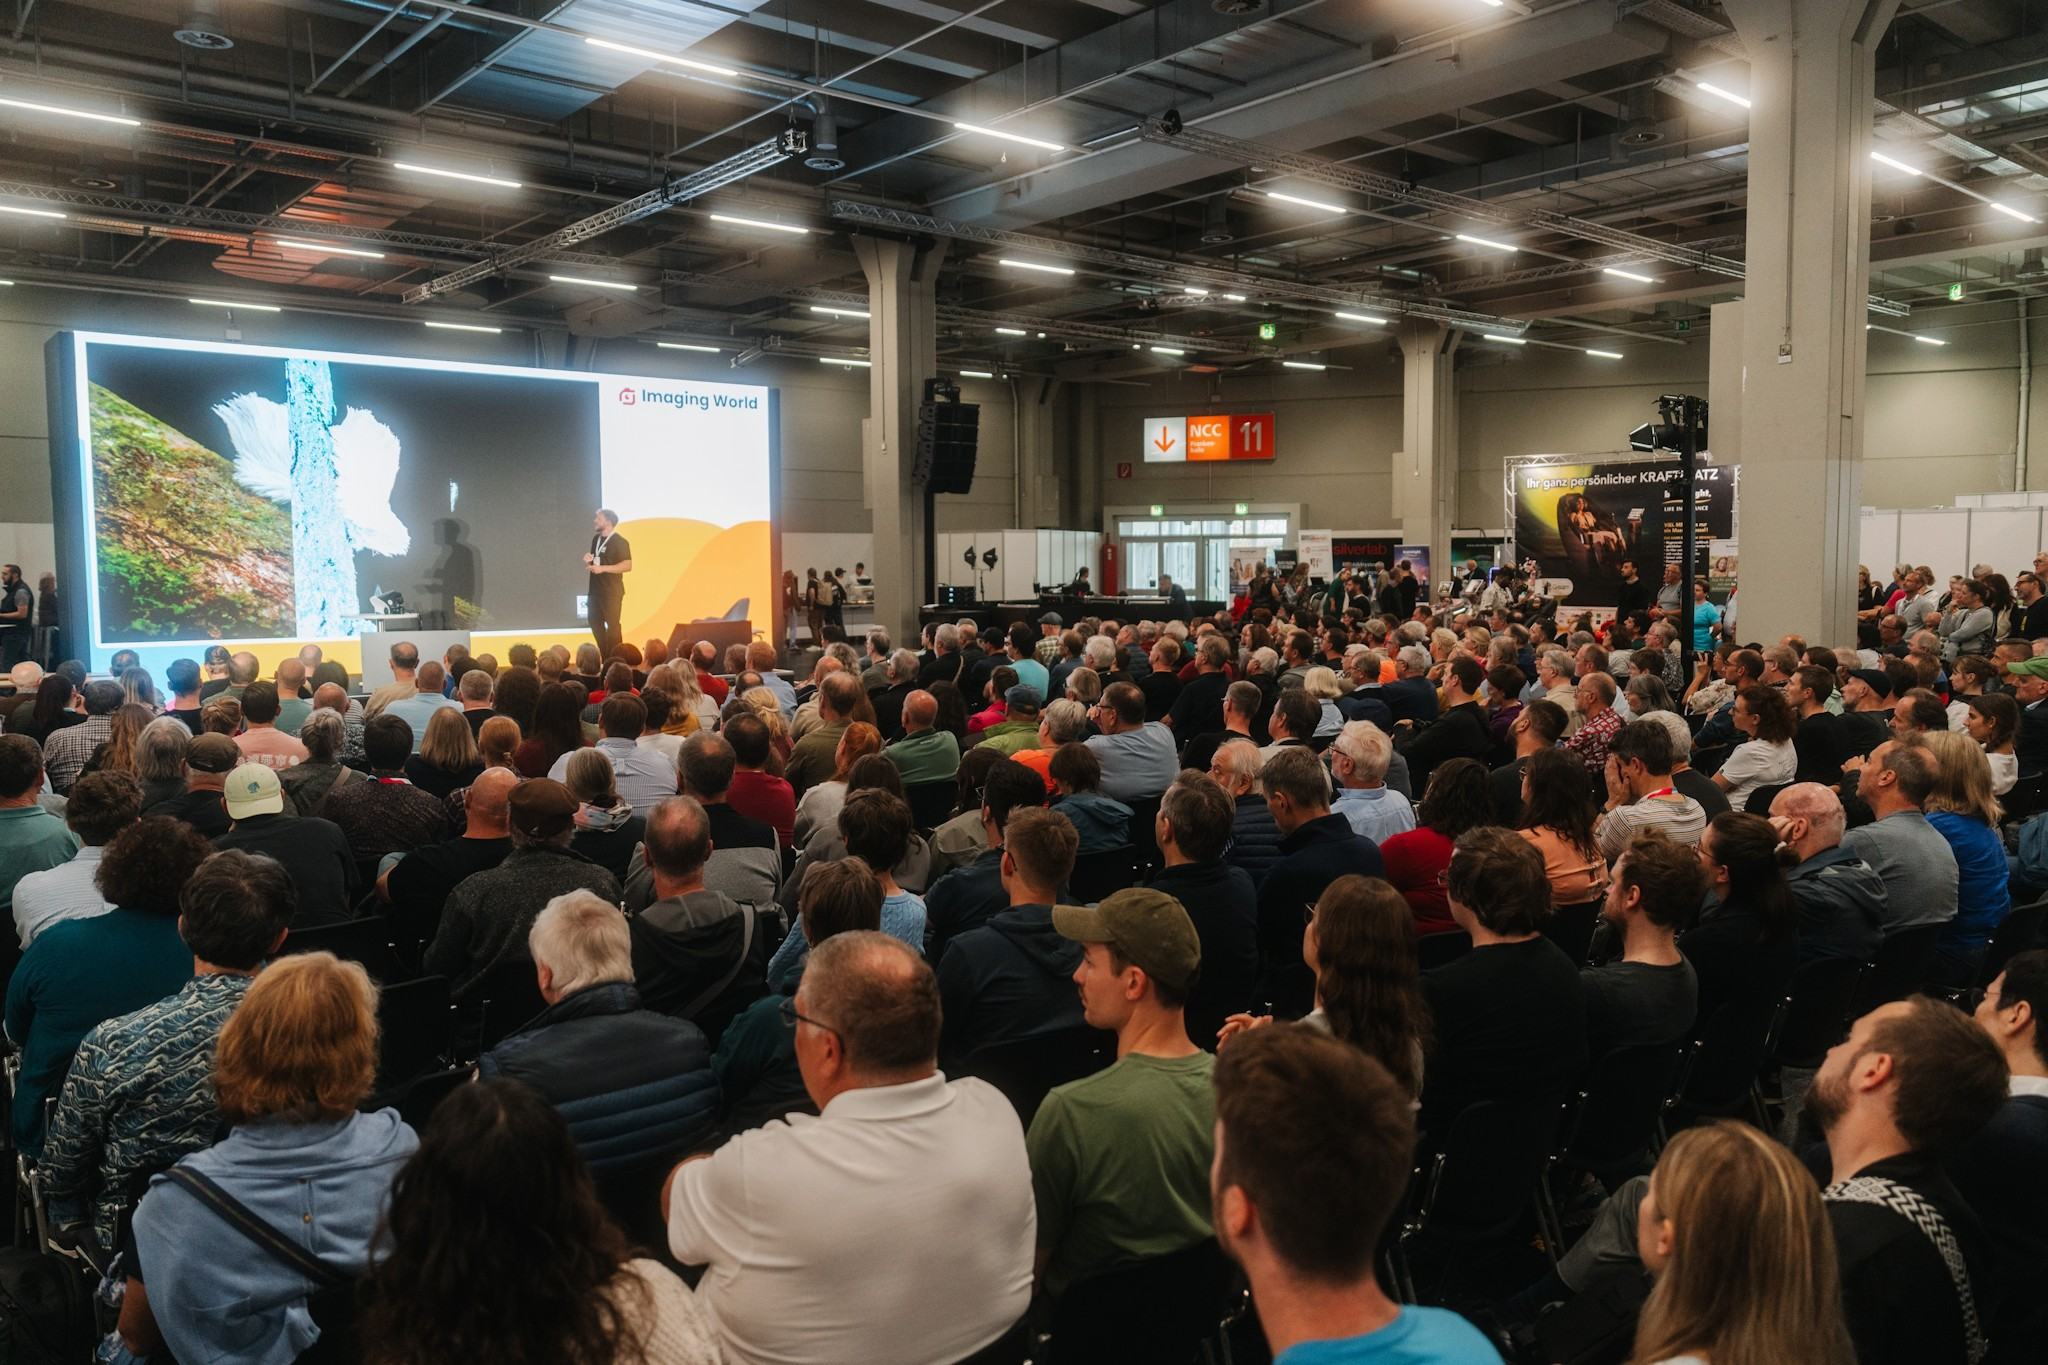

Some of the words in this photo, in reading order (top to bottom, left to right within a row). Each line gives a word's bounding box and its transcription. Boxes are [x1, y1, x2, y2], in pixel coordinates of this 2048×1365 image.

[642, 389, 708, 410] Imaging
[713, 394, 758, 410] World
[1189, 423, 1222, 438] NCC
[1240, 422, 1262, 452] 11
[1526, 478, 1540, 489] Ihr
[1543, 478, 1568, 490] ganz
[1570, 473, 1636, 488] persönlicher
